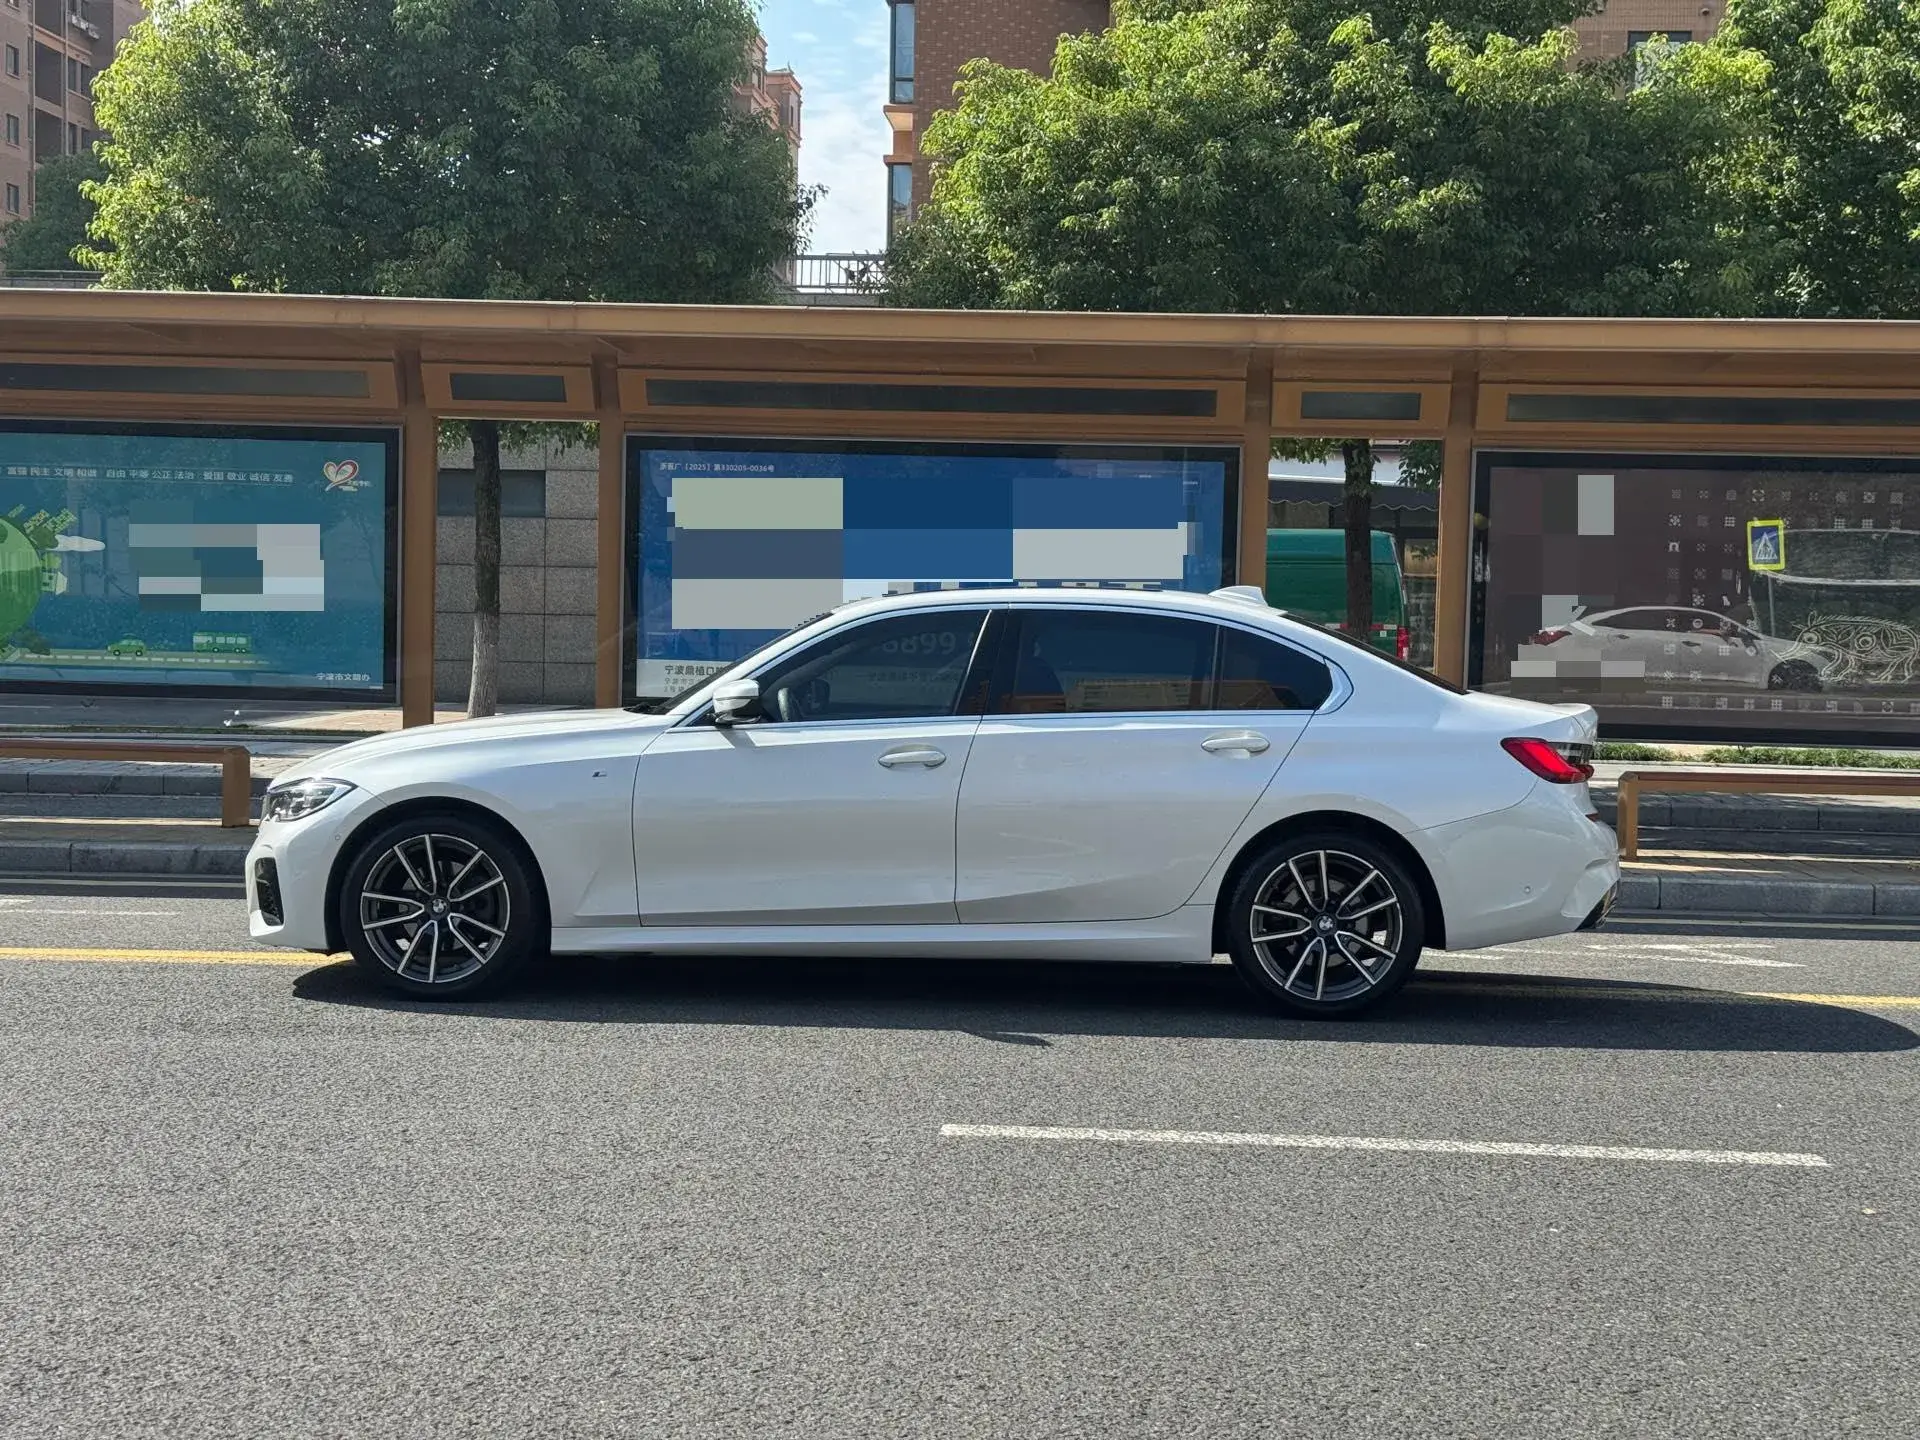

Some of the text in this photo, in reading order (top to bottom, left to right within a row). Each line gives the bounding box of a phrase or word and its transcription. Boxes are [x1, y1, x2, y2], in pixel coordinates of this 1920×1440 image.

[7, 466, 293, 483] 富强 民主 文明 和谐 自由 平等 公正 法治 爱国 敬业 诚信 友善
[315, 672, 371, 681] 宁波市文明办
